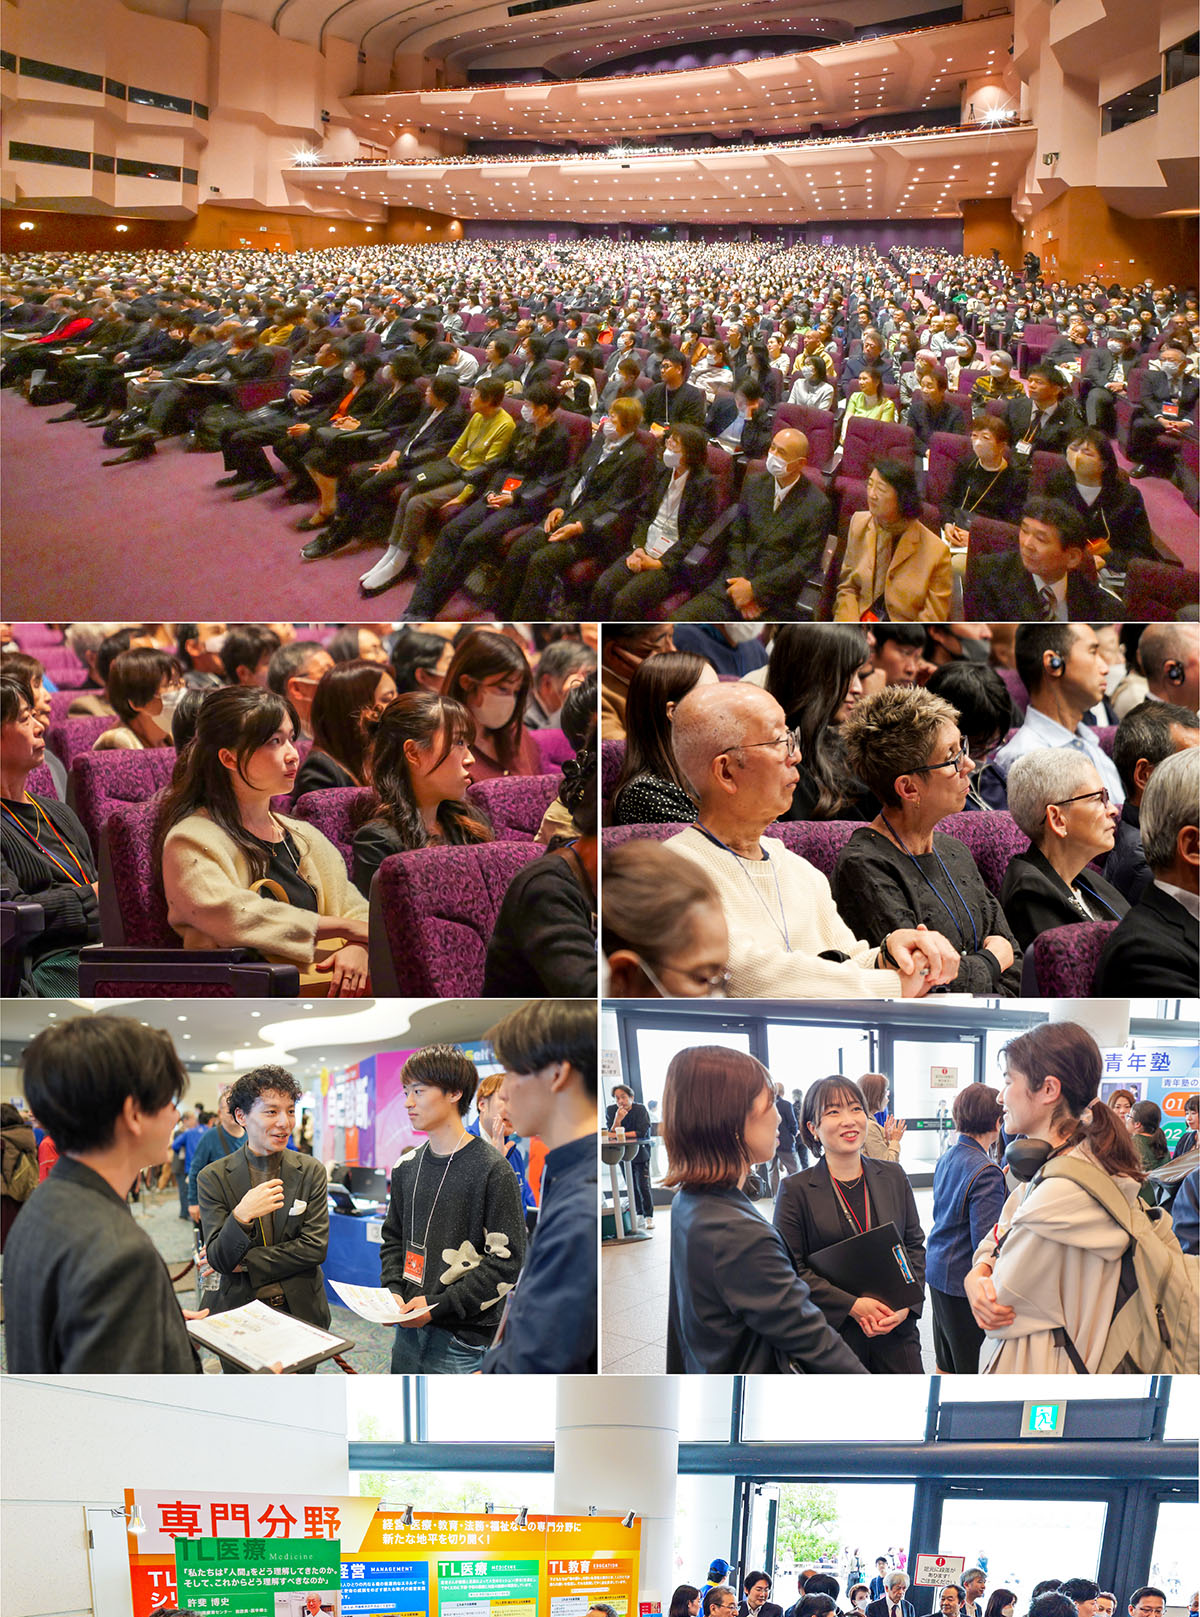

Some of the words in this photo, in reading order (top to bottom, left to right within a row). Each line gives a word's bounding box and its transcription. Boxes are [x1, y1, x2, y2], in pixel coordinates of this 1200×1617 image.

[1104, 1052, 1171, 1072] 青年塾
[1165, 1098, 1184, 1110] 01
[1164, 1128, 1183, 1139] 02
[157, 1500, 342, 1539] 専門分野
[175, 1537, 267, 1561] TL医療
[269, 1553, 313, 1561] Medicine
[438, 1562, 488, 1577] TL医療
[548, 1560, 591, 1574] TL教育
